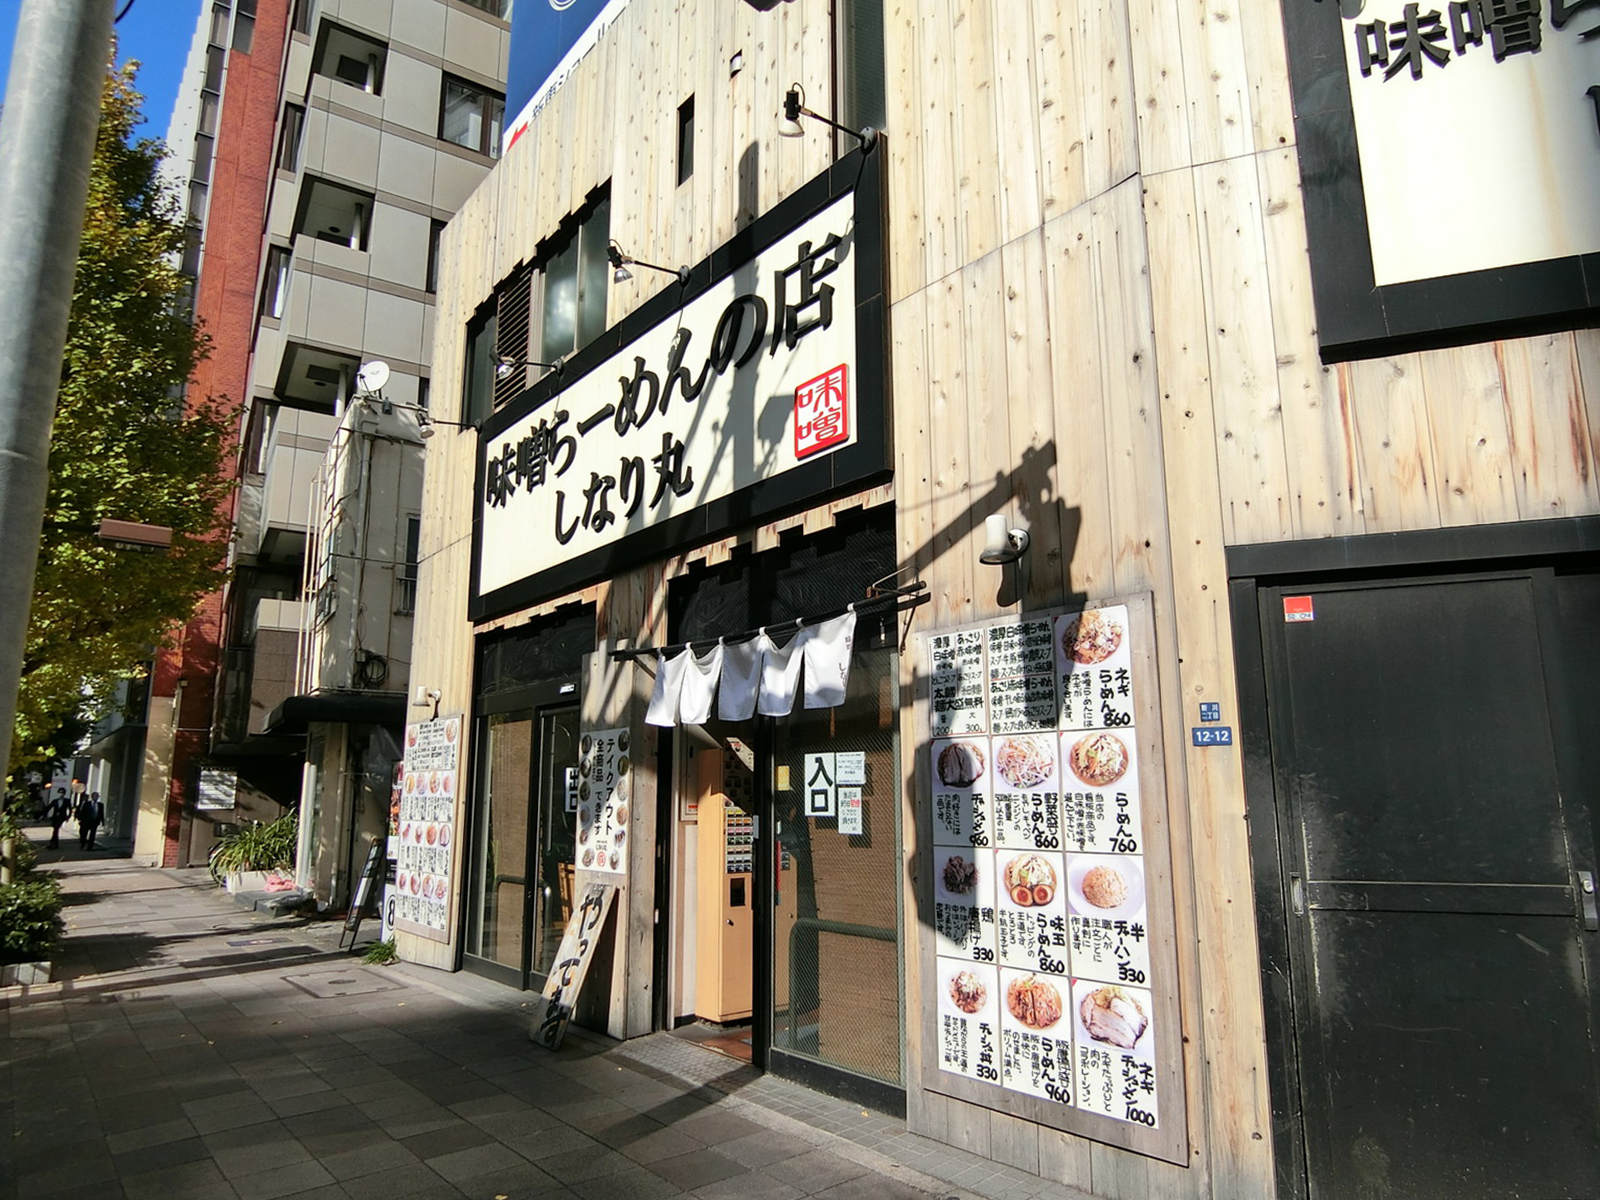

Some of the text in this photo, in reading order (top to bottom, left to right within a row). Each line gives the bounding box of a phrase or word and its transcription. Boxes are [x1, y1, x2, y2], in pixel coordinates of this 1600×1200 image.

[486, 232, 842, 510] 味噌らーめんの店
[797, 375, 844, 443] 味噌
[554, 432, 694, 546] しなり丸
[1099, 669, 1117, 714] らーめん
[1114, 667, 1131, 698] ネギ
[1103, 712, 1132, 728] 860
[1196, 730, 1230, 742] 12-12
[595, 738, 605, 783] 全商品
[569, 769, 579, 810] 出口
[605, 738, 615, 836] テイクアウト
[807, 756, 834, 813] 入口
[593, 791, 604, 836] できます
[1031, 793, 1045, 835] らーめん
[1116, 791, 1133, 838] らーめん
[969, 833, 989, 848] 960
[1034, 834, 1059, 849] 860
[1108, 838, 1137, 853] 760
[1036, 913, 1051, 958] らーめん
[1114, 920, 1131, 966] チャーハン
[1130, 922, 1145, 943] 半
[972, 946, 995, 962] 330
[1039, 958, 1065, 974] 860
[1118, 966, 1146, 984] 330
[976, 1063, 998, 1081] 330
[1041, 1036, 1056, 1083] らーめん
[1044, 1082, 1071, 1105] 960
[1139, 1062, 1155, 1096] ネギ
[1126, 1106, 1155, 1127] 1000
